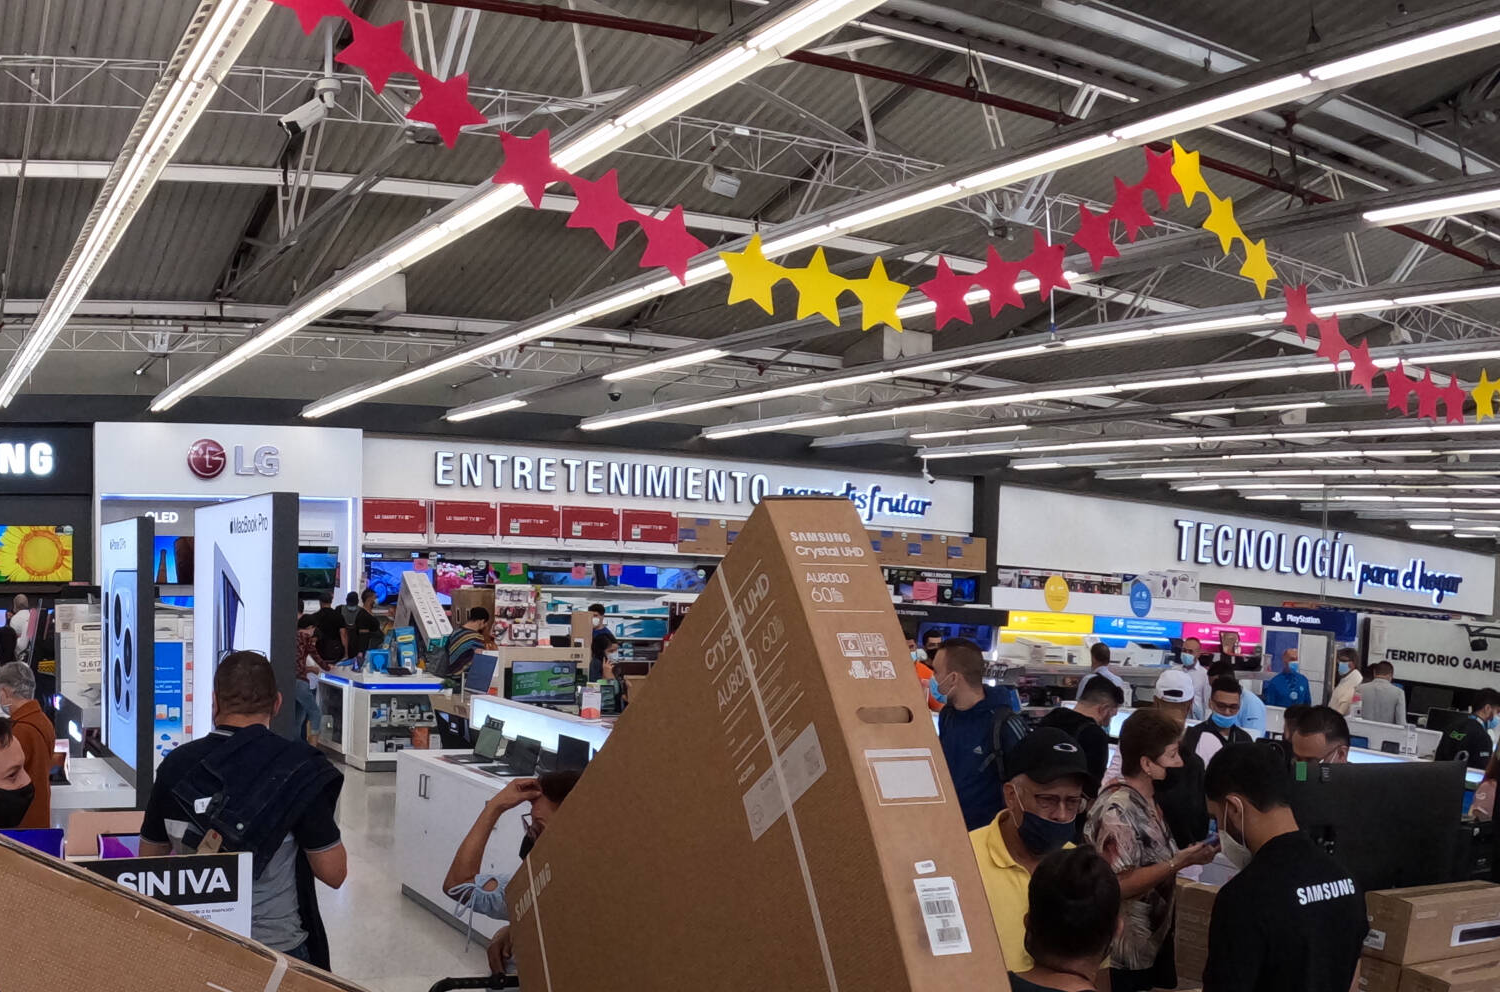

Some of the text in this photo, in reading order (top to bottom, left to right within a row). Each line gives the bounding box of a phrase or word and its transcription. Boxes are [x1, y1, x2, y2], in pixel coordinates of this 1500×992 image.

[234, 445, 281, 477] LG
[434, 450, 770, 505] ENTRETENIMIENTO
[233, 512, 269, 534] MacBook Pro
[789, 531, 852, 543] SAMSUNG
[795, 545, 865, 560] Crystal UHD
[1174, 518, 1356, 582] TECNOLOGÍA
[1355, 561, 1399, 596] para
[806, 571, 850, 584] AU8000
[743, 572, 771, 617] UHD
[1286, 613, 1321, 626] PlayStation
[1386, 648, 1460, 668] TERRITORIO
[116, 867, 231, 897] SIN IVA
[1296, 877, 1356, 906] SAMSUNG
